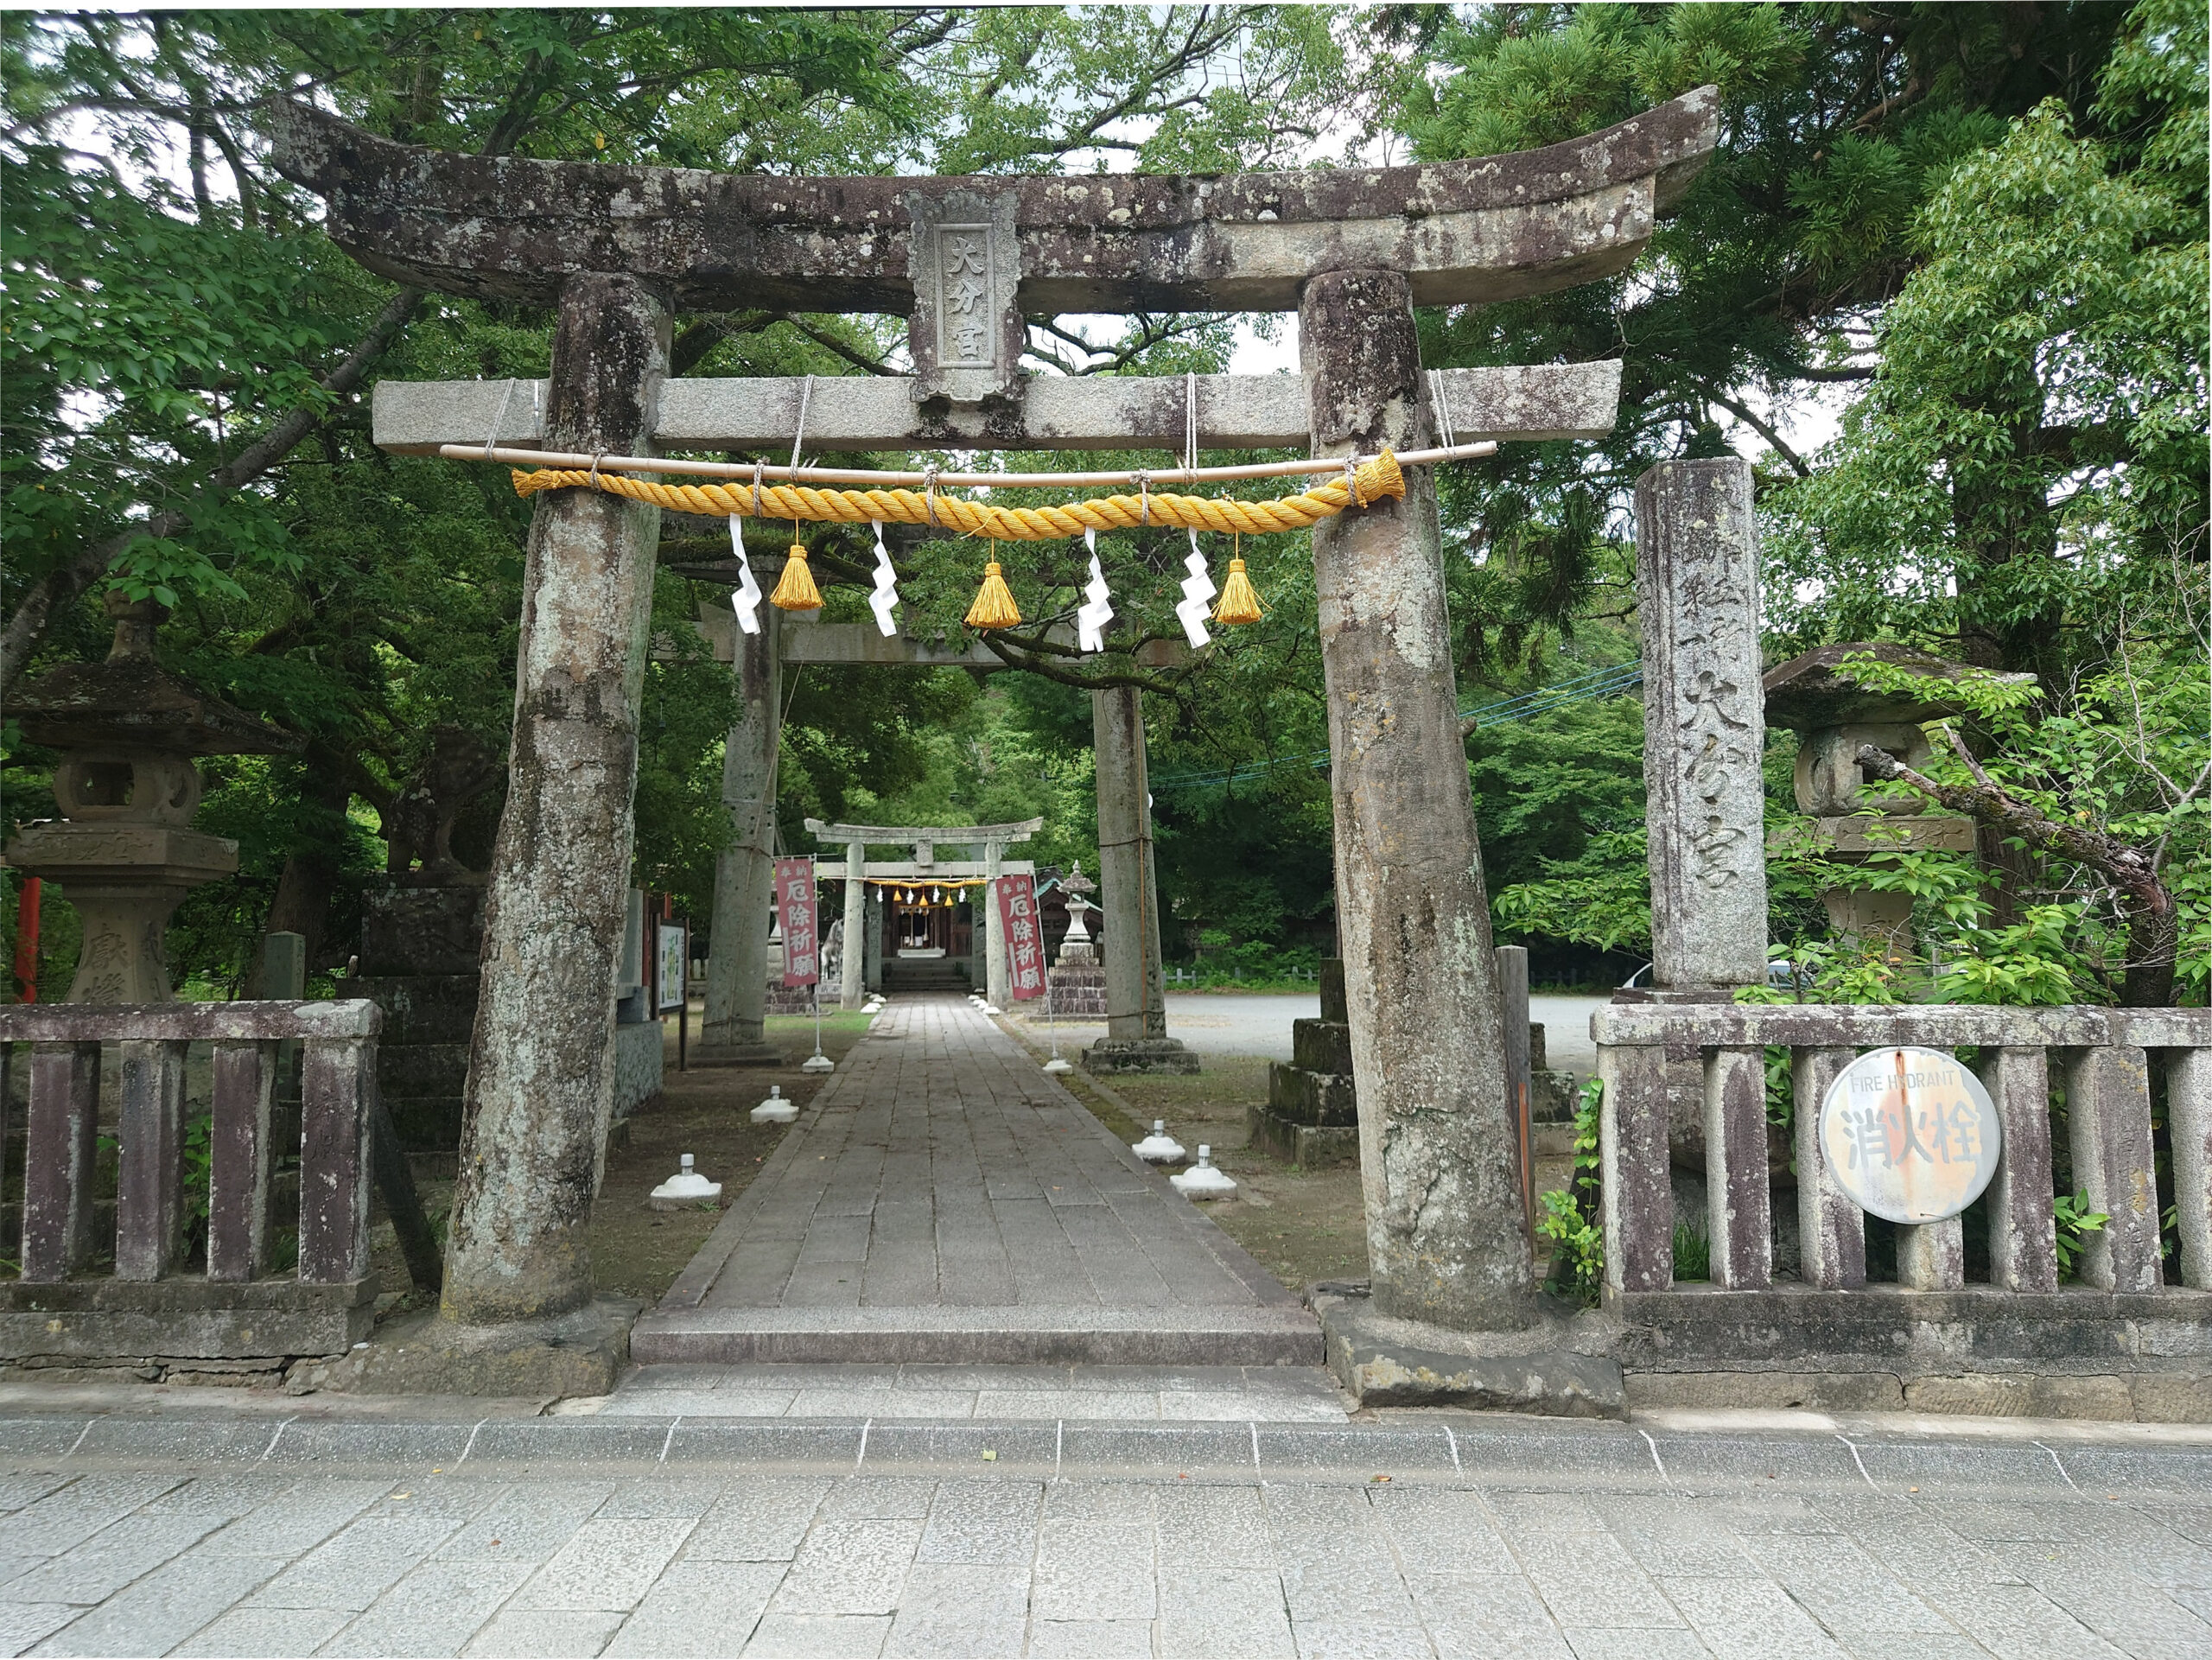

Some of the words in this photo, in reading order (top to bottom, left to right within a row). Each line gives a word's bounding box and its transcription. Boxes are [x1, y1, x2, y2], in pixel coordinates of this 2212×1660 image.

[949, 236, 985, 357] 大分宮
[780, 865, 808, 880] 奉納
[785, 879, 817, 977] 厄除祈願
[1008, 894, 1042, 990] 厄除祈願
[1850, 1075, 1884, 1093] FIRE
[1887, 1070, 1955, 1091] HYDRANT
[1840, 1099, 1981, 1170] 消火栓
